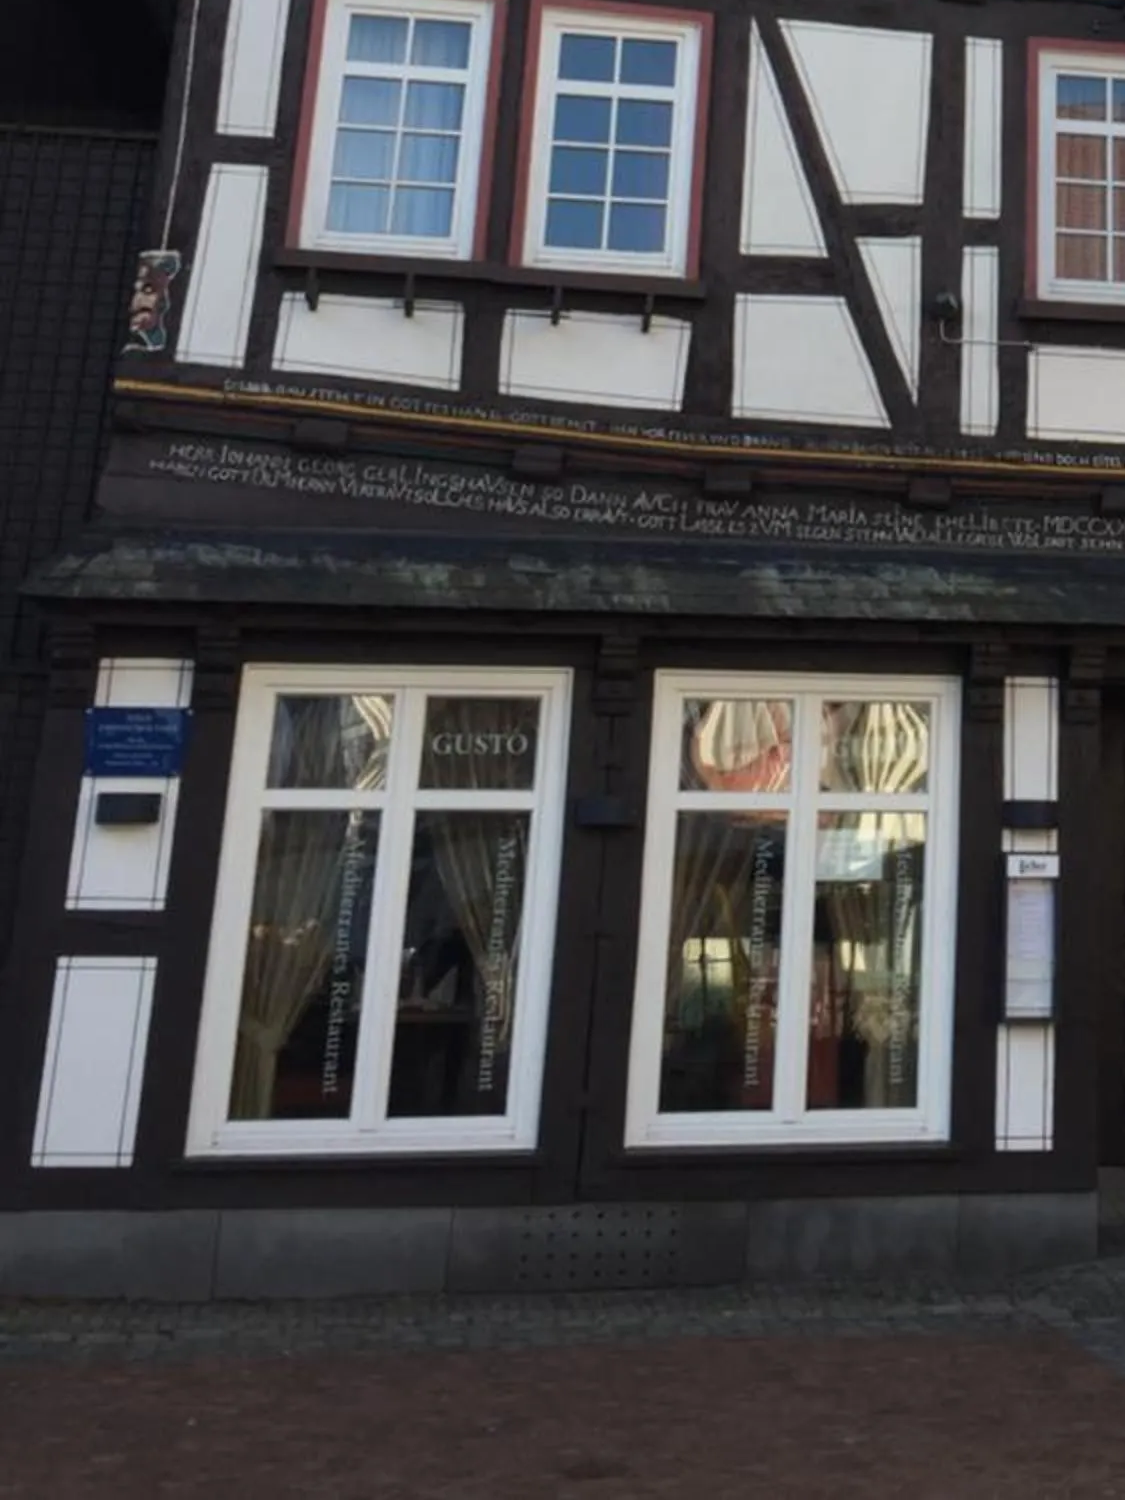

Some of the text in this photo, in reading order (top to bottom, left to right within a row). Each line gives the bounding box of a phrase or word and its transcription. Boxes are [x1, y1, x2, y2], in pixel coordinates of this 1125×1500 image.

[741, 500, 800, 520] ANNA
[432, 732, 529, 756] GUSTO
[322, 839, 366, 1094] Mediterranes Restaurant
[478, 837, 518, 1092] Mediterranes Restaurant
[743, 977, 767, 1088] Restaurant
